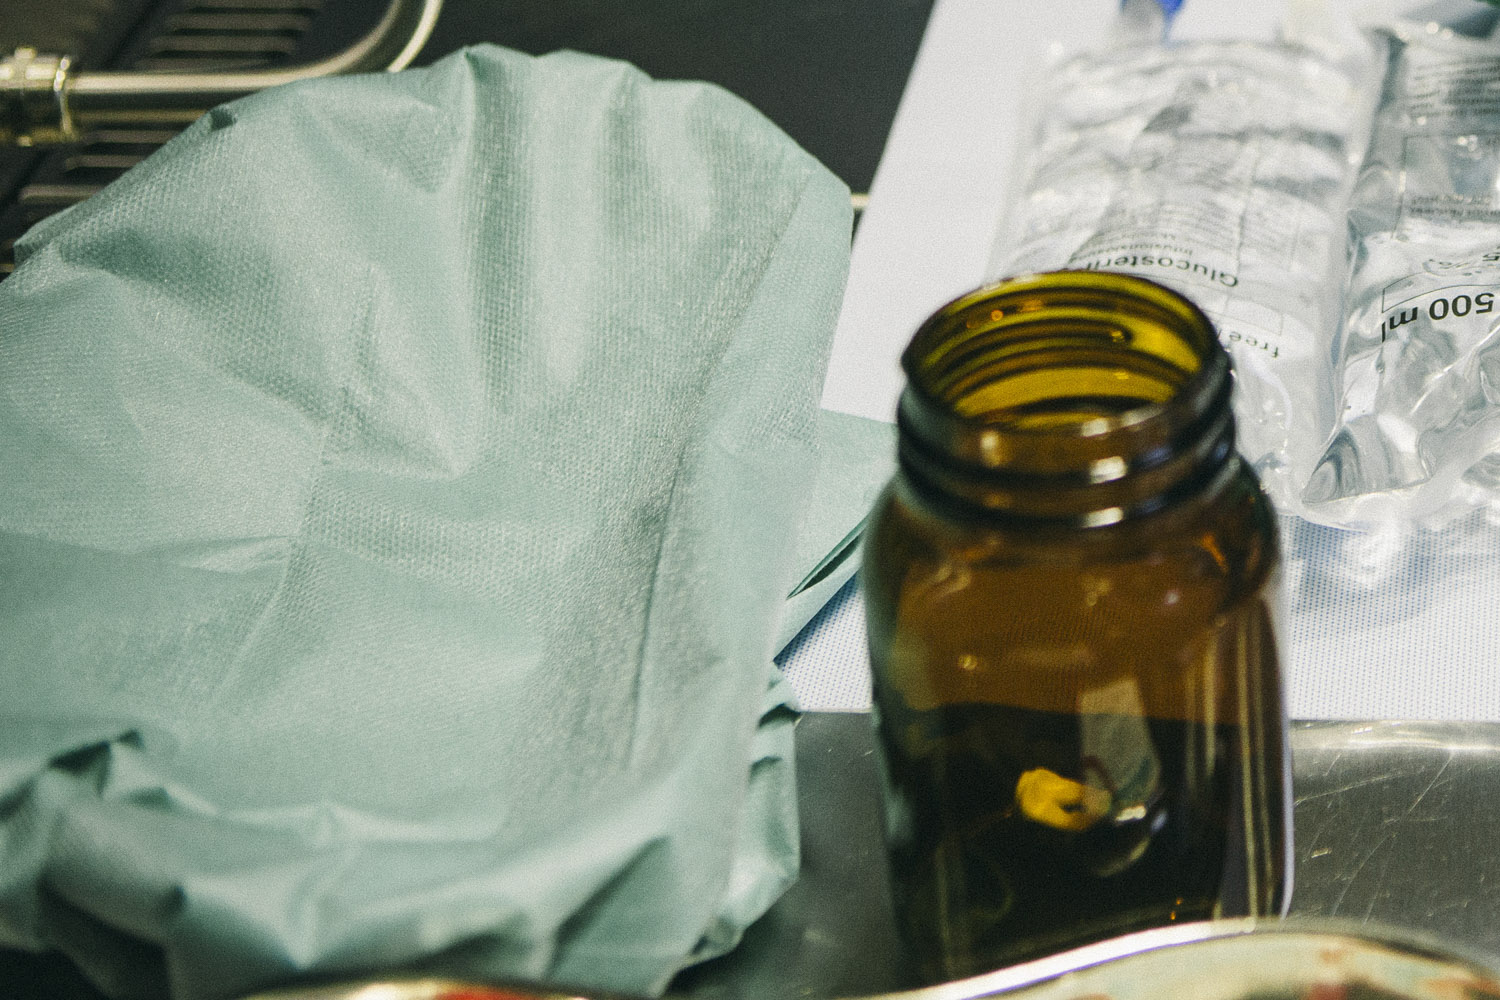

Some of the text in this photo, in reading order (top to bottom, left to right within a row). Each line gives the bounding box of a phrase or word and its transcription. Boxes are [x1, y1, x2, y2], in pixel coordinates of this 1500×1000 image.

[1381, 293, 1495, 342] 500 ml
[1228, 330, 1279, 358] free
